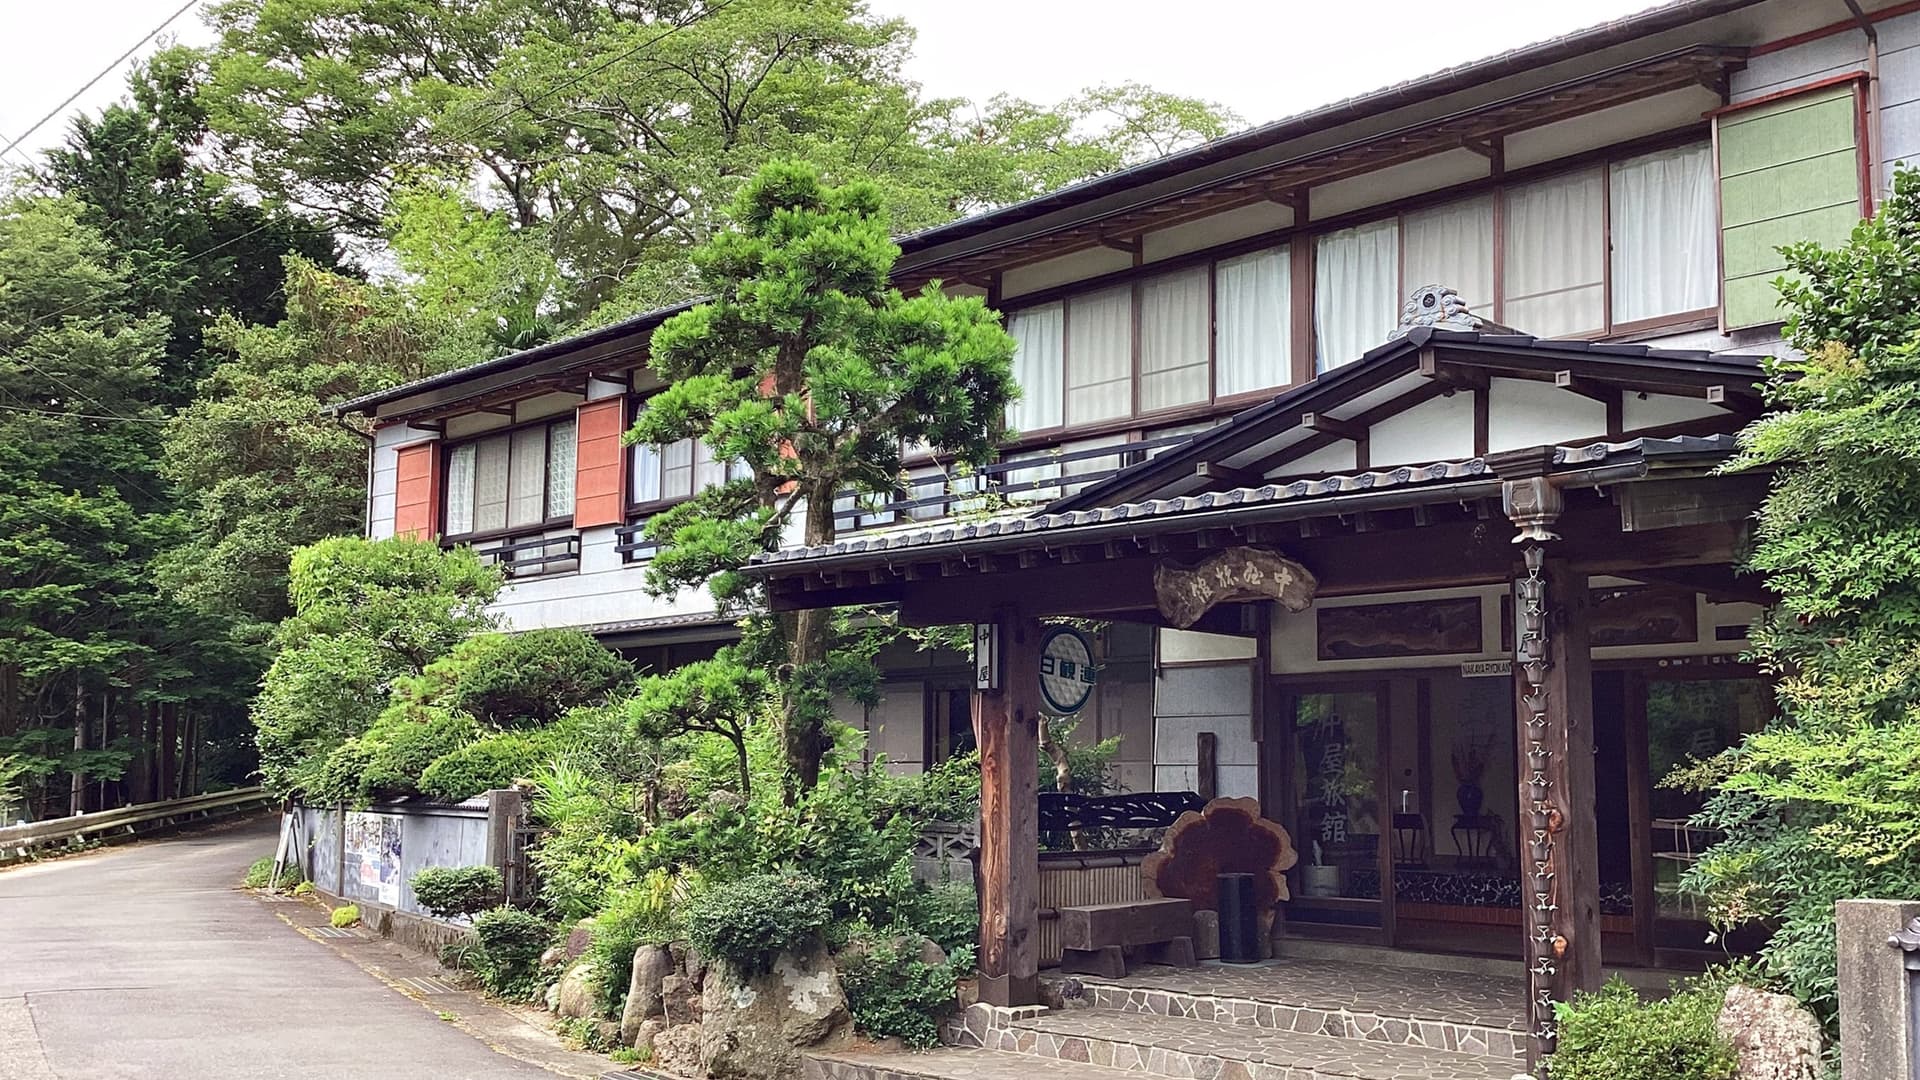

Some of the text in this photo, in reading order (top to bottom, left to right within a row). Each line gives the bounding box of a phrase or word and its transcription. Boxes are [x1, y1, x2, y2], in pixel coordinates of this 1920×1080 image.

[979, 629, 989, 682] 中屋
[1041, 656, 1097, 685] 日観連
